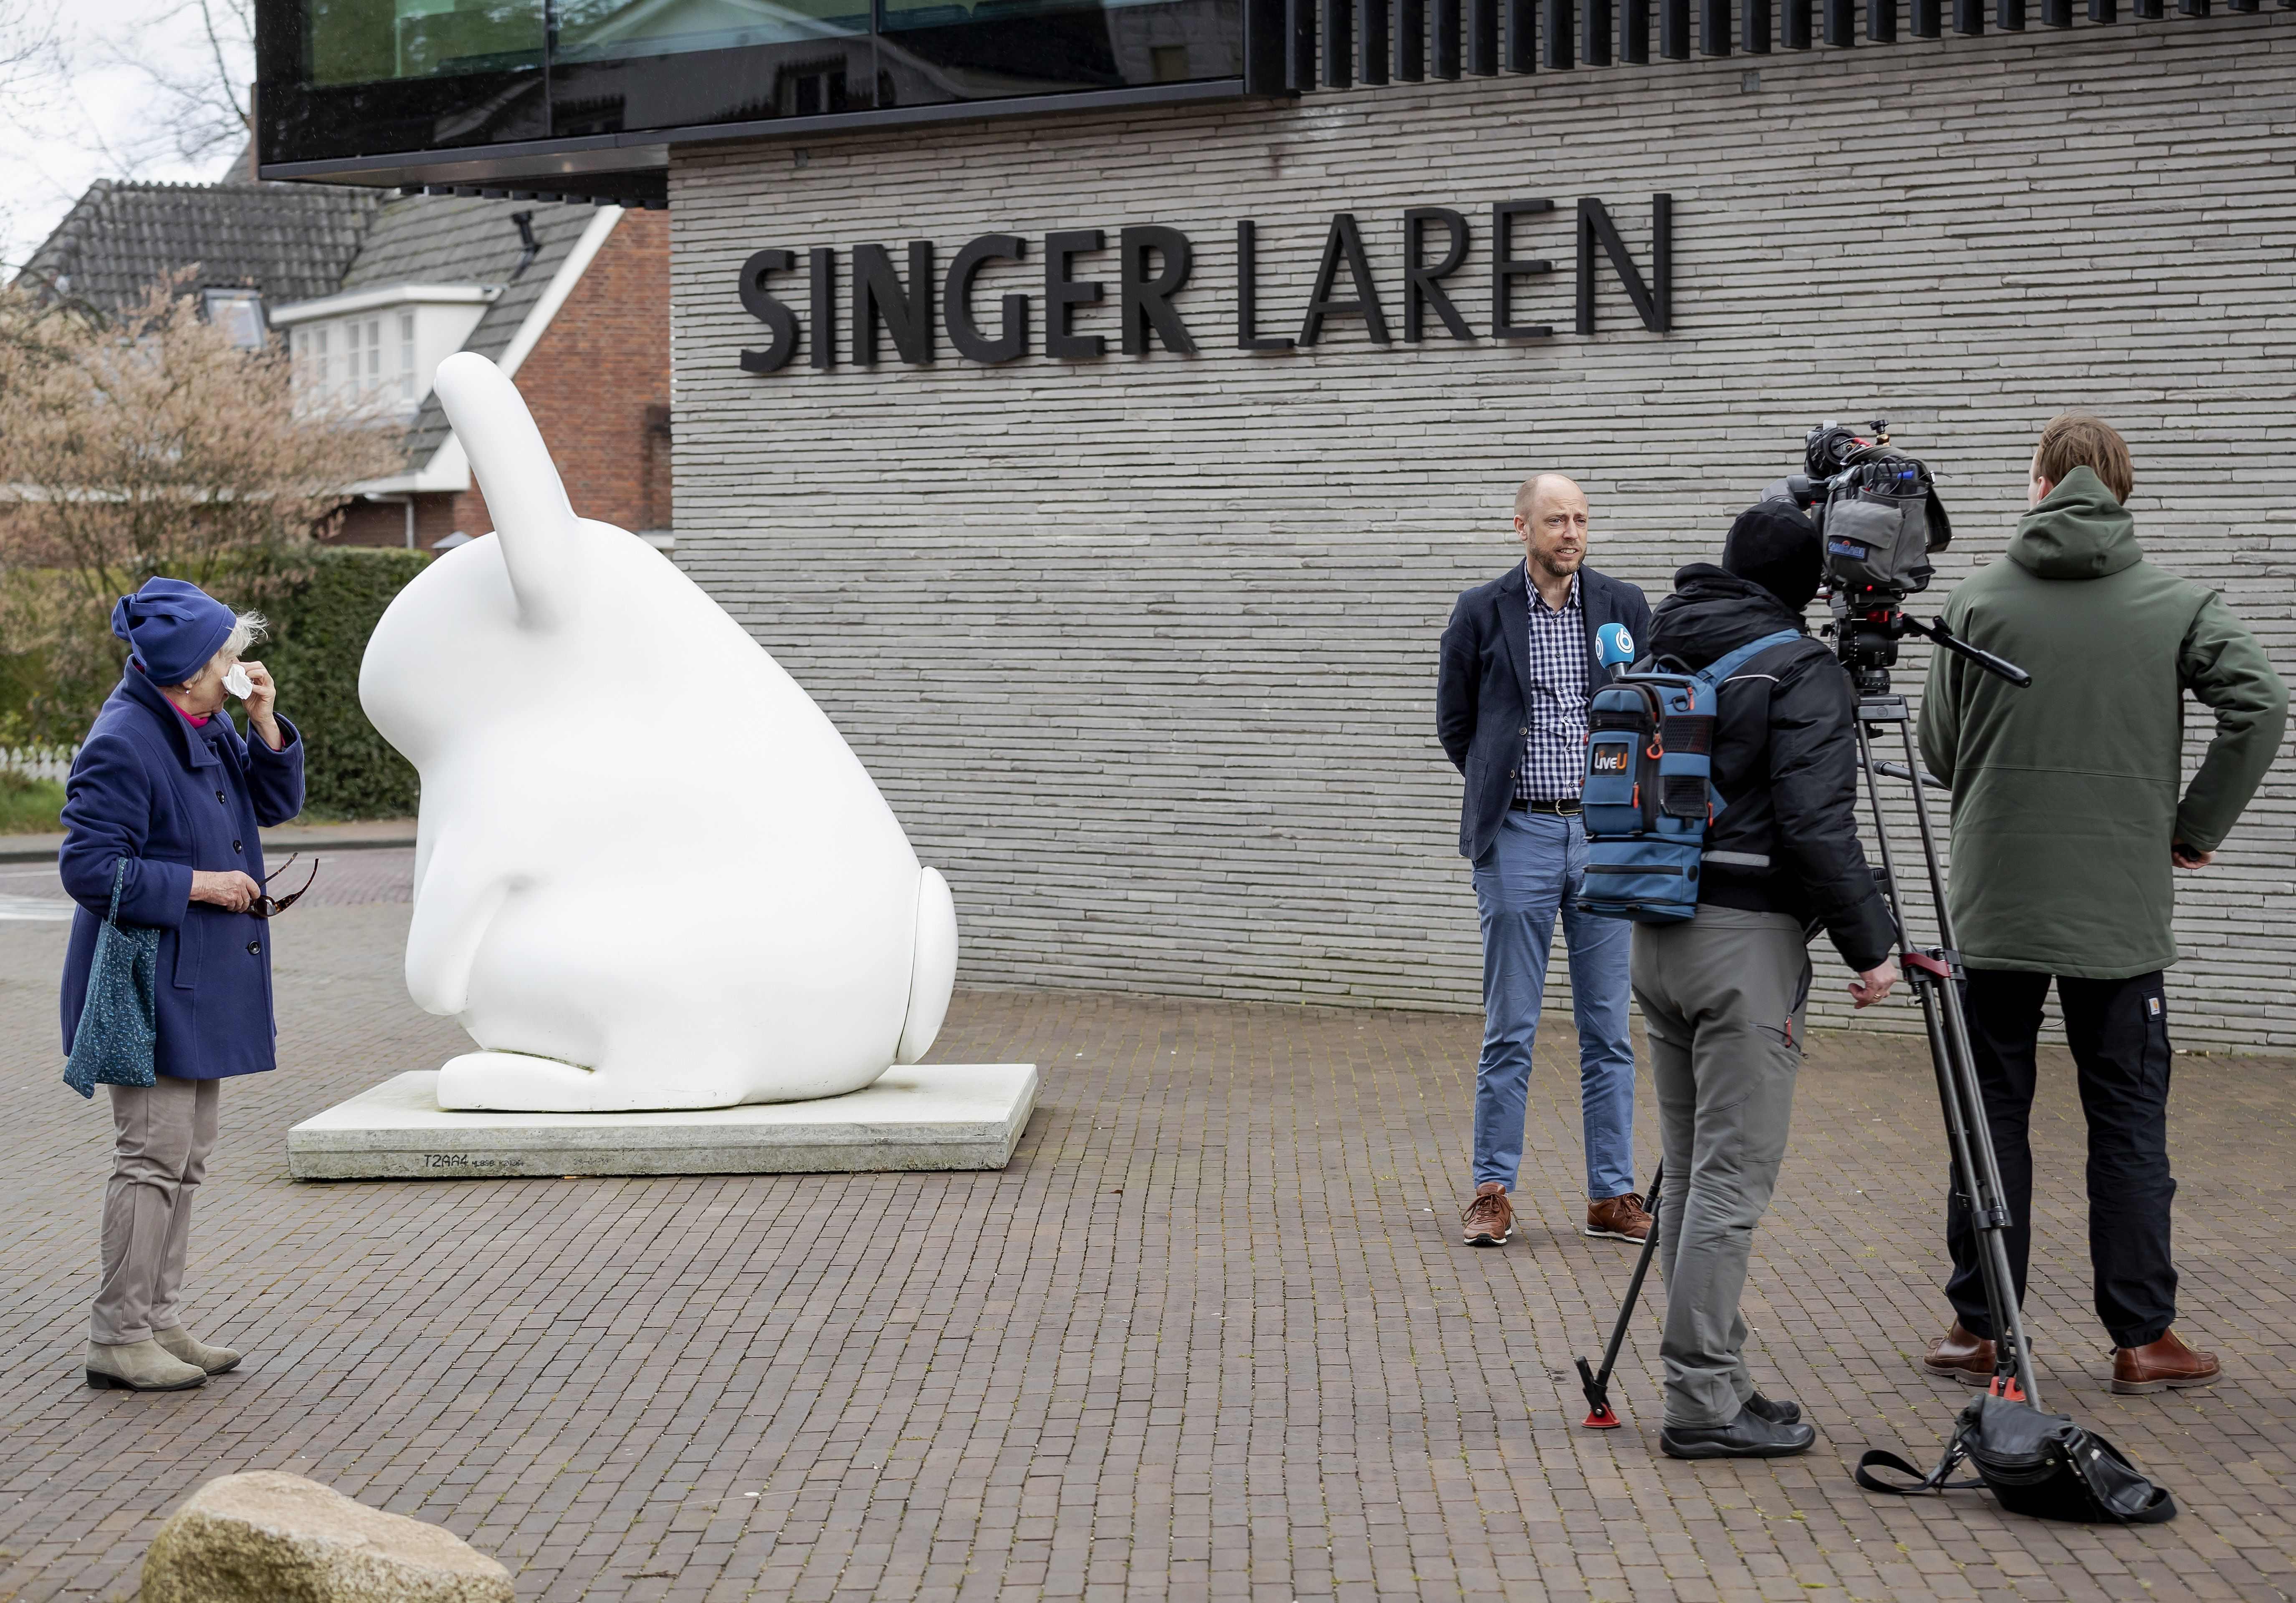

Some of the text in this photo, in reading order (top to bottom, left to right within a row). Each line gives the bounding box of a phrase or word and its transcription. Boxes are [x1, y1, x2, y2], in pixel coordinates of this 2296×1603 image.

[739, 193, 1671, 373] SINGER LAREN
[424, 1154, 468, 1167] T2AA4
